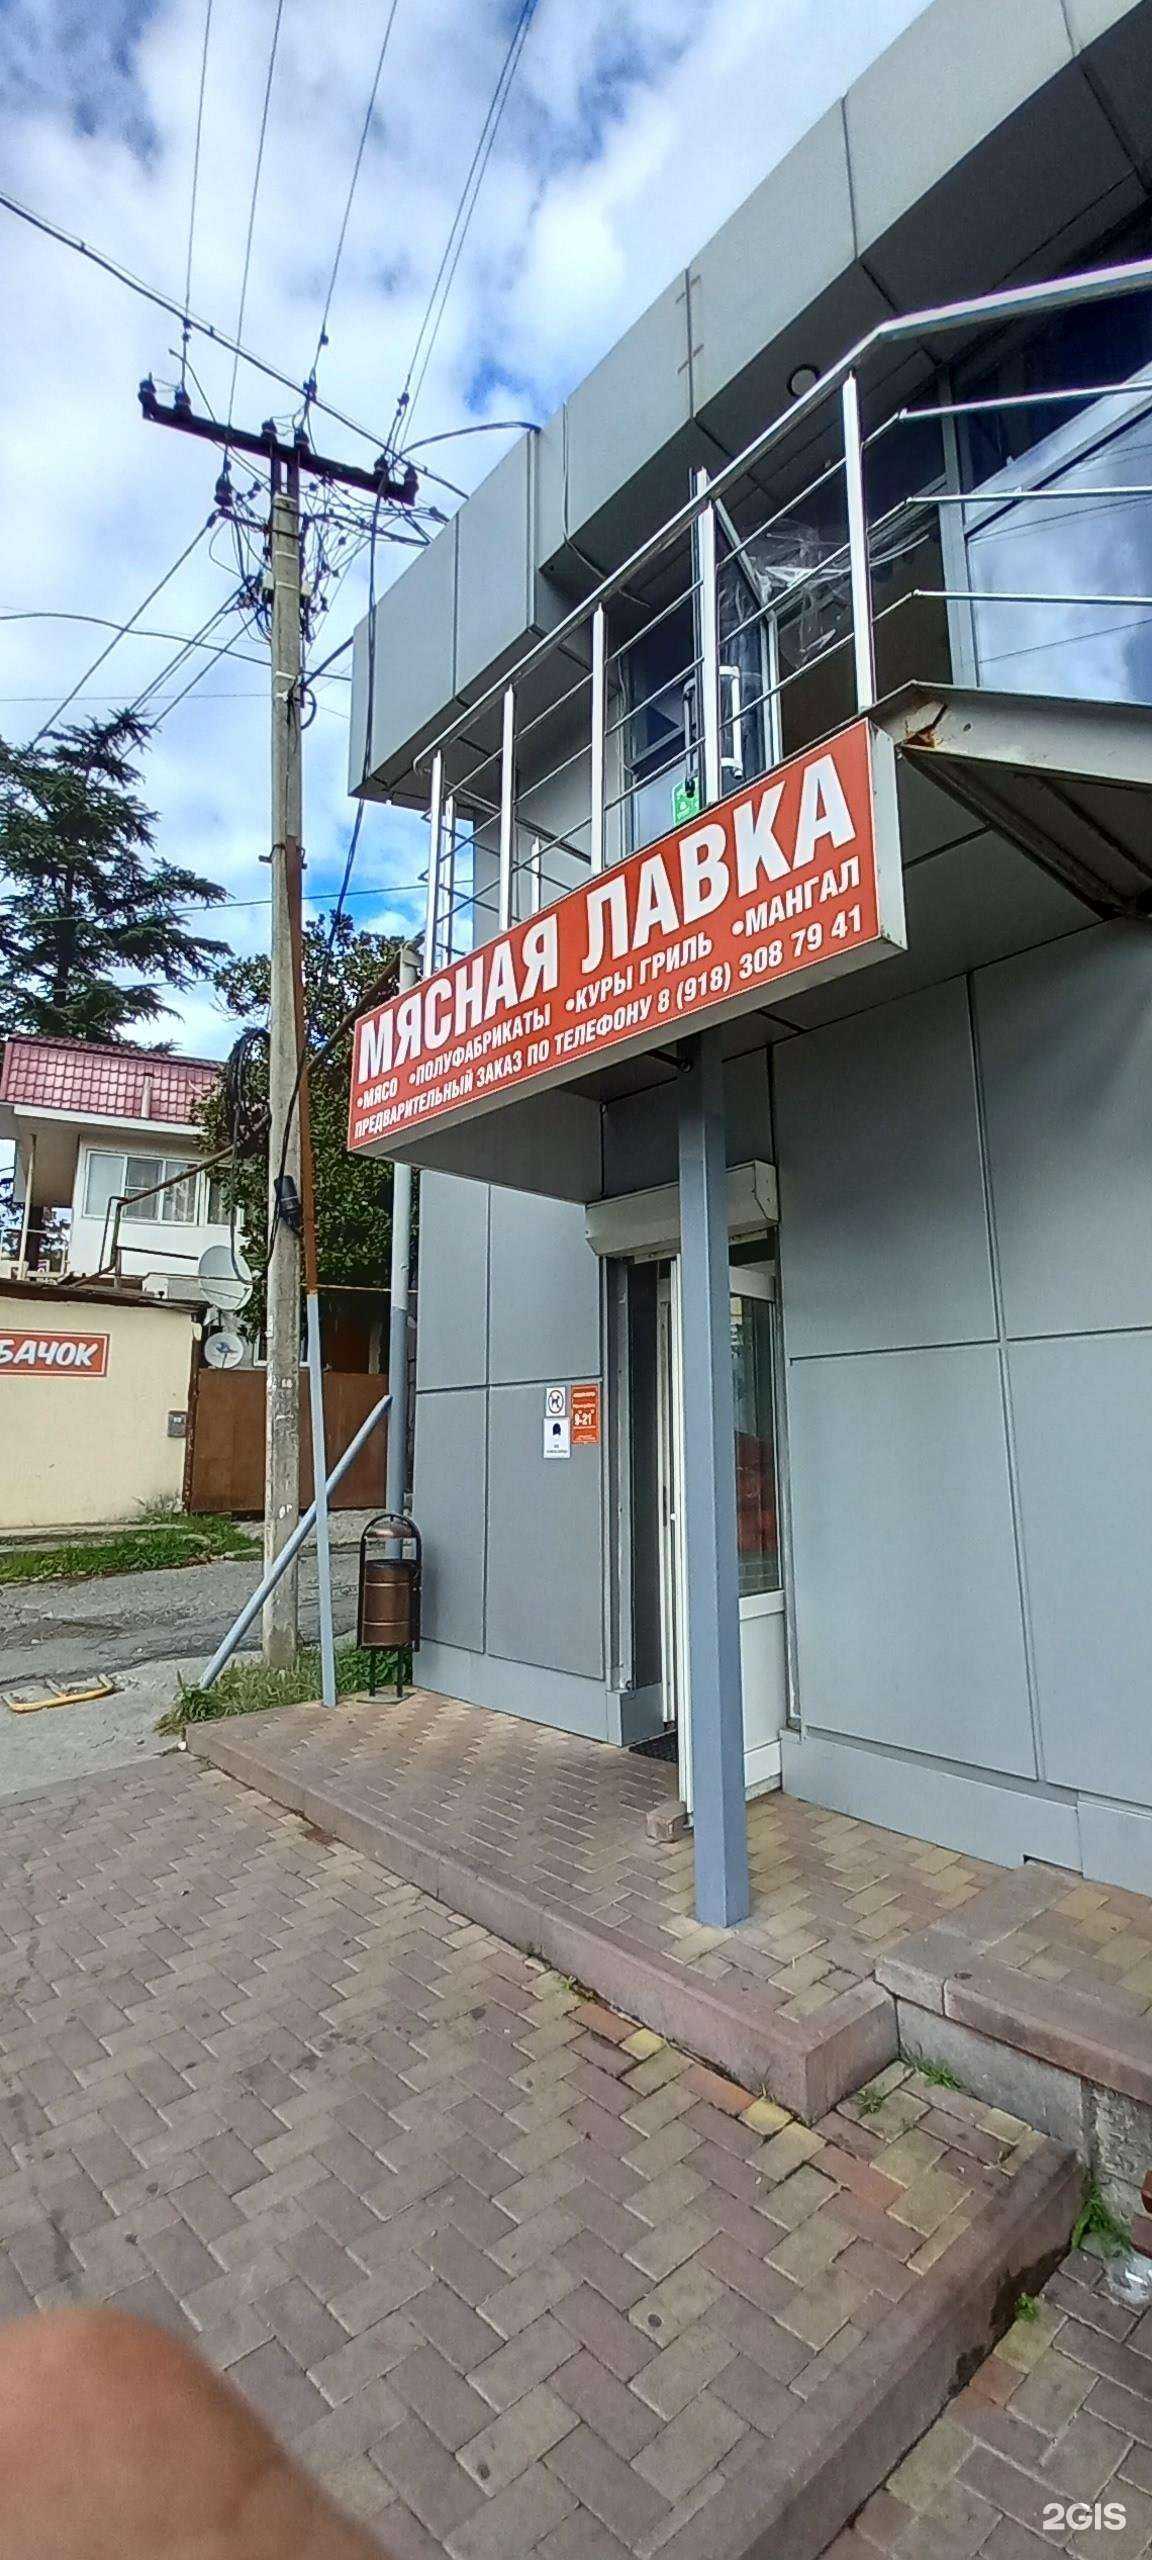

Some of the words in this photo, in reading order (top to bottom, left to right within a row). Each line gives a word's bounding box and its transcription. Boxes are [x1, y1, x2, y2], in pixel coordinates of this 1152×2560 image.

[354, 1069, 474, 1140] ПРЕДВАРИТЕЛЬНЫЙ
[476, 1050, 523, 1088] ЗАКАЗ
[527, 1039, 550, 1067] ПО
[554, 994, 653, 1056] ТЕЛЕФОНУ
[657, 988, 670, 1014] 8
[676, 962, 731, 1010] (918)
[738, 940, 784, 980] 308
[790, 923, 823, 958] 79
[831, 904, 862, 939] 41
[358, 914, 558, 1085] МЯСНАЯ
[581, 753, 857, 974] ЛАВКА
[639, 931, 713, 985] ГРИЛЬ
